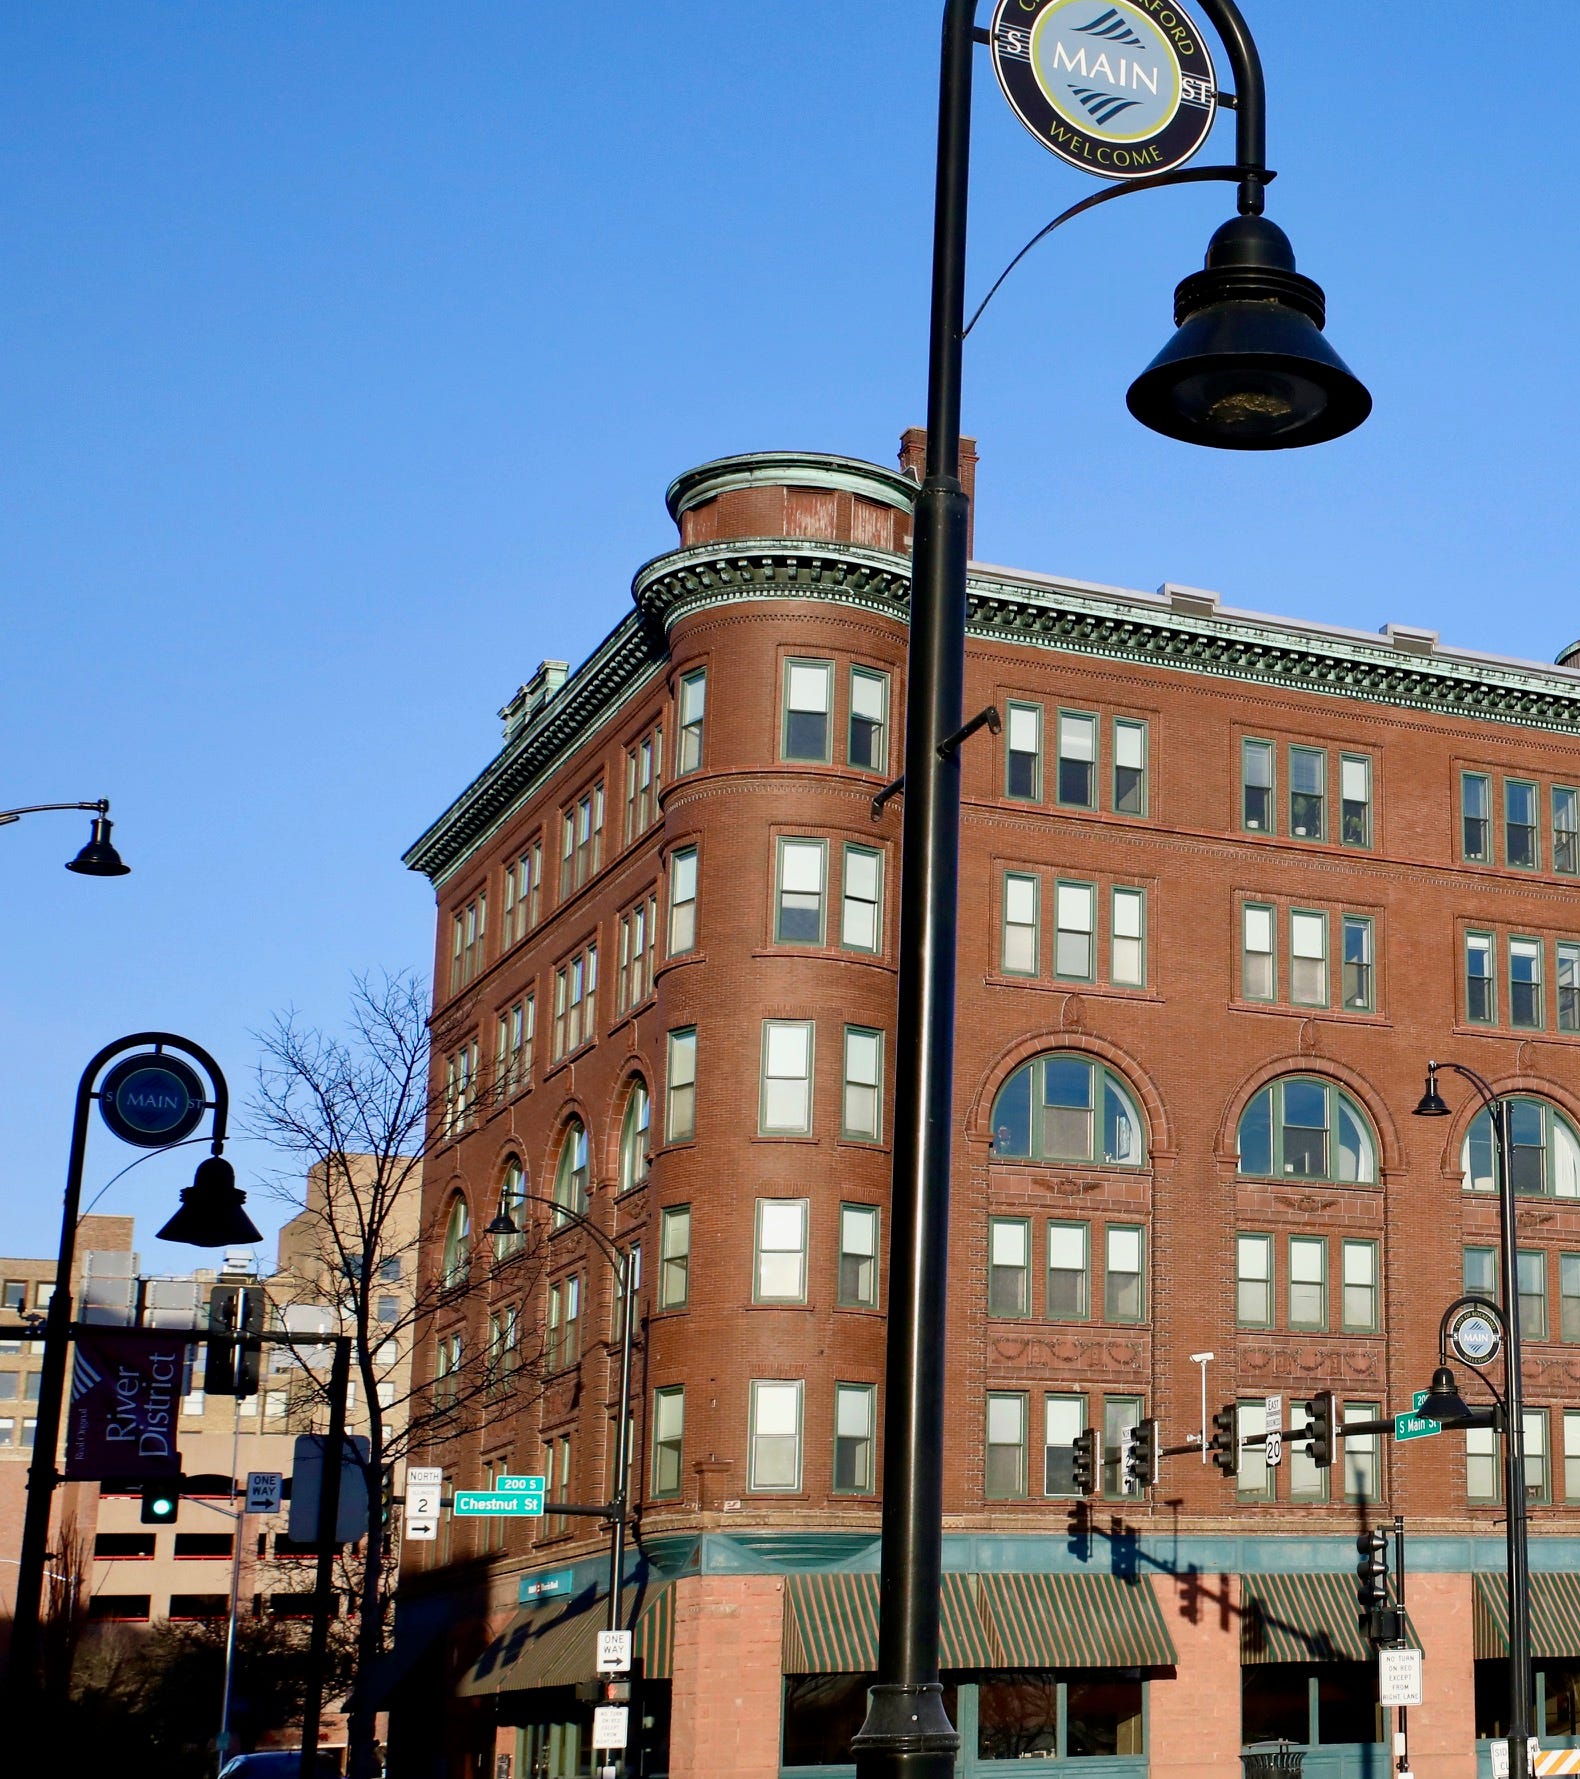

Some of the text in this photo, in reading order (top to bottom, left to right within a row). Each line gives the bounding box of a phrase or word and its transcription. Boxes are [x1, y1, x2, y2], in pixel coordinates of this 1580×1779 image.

[1007, 31, 1211, 104] S MAIN ST
[1050, 121, 1164, 167] WELCOME
[127, 1093, 178, 1109] MAIN
[1463, 1333, 1488, 1342] MAIN
[1492, 1334, 1500, 1342] ST
[1464, 1354, 1490, 1363] WELCOME
[106, 1366, 139, 1440] River
[139, 1352, 176, 1456] District
[1268, 1399, 1279, 1411] EAST
[1400, 1421, 1405, 1434] S
[1408, 1418, 1426, 1432] Main
[1267, 1440, 1280, 1459] 20
[254, 1475, 276, 1485] ONE
[410, 1472, 439, 1481] NORTH
[504, 1479, 537, 1489] 200 S
[252, 1486, 276, 1496] WAY
[418, 1498, 428, 1512] 2
[460, 1497, 538, 1510] Chestnut St
[605, 1635, 624, 1644] ONE
[603, 1645, 624, 1654] WAY
